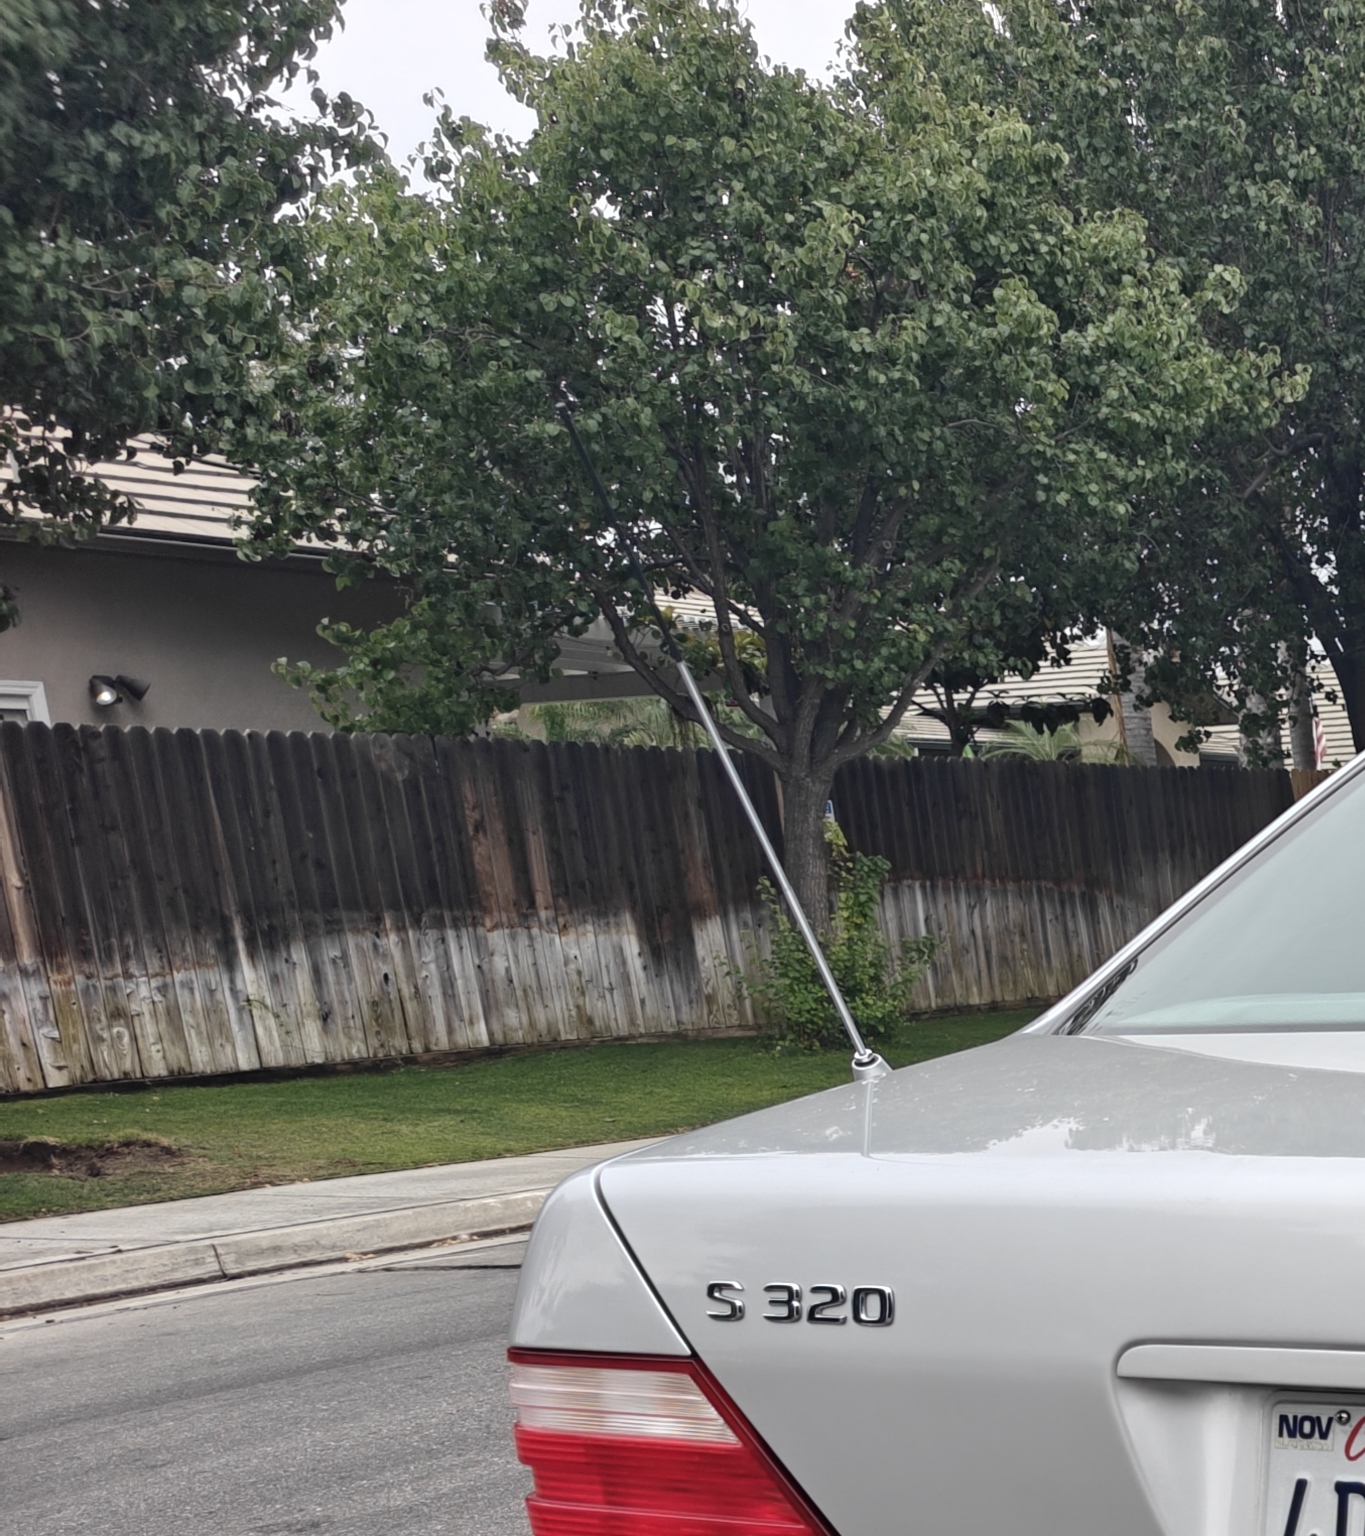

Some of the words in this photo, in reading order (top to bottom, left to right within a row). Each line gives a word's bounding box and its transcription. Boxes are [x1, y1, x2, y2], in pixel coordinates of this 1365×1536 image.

[706, 1280, 745, 1322] S
[762, 1282, 895, 1327] 320
[1278, 1414, 1334, 1440] NOV
